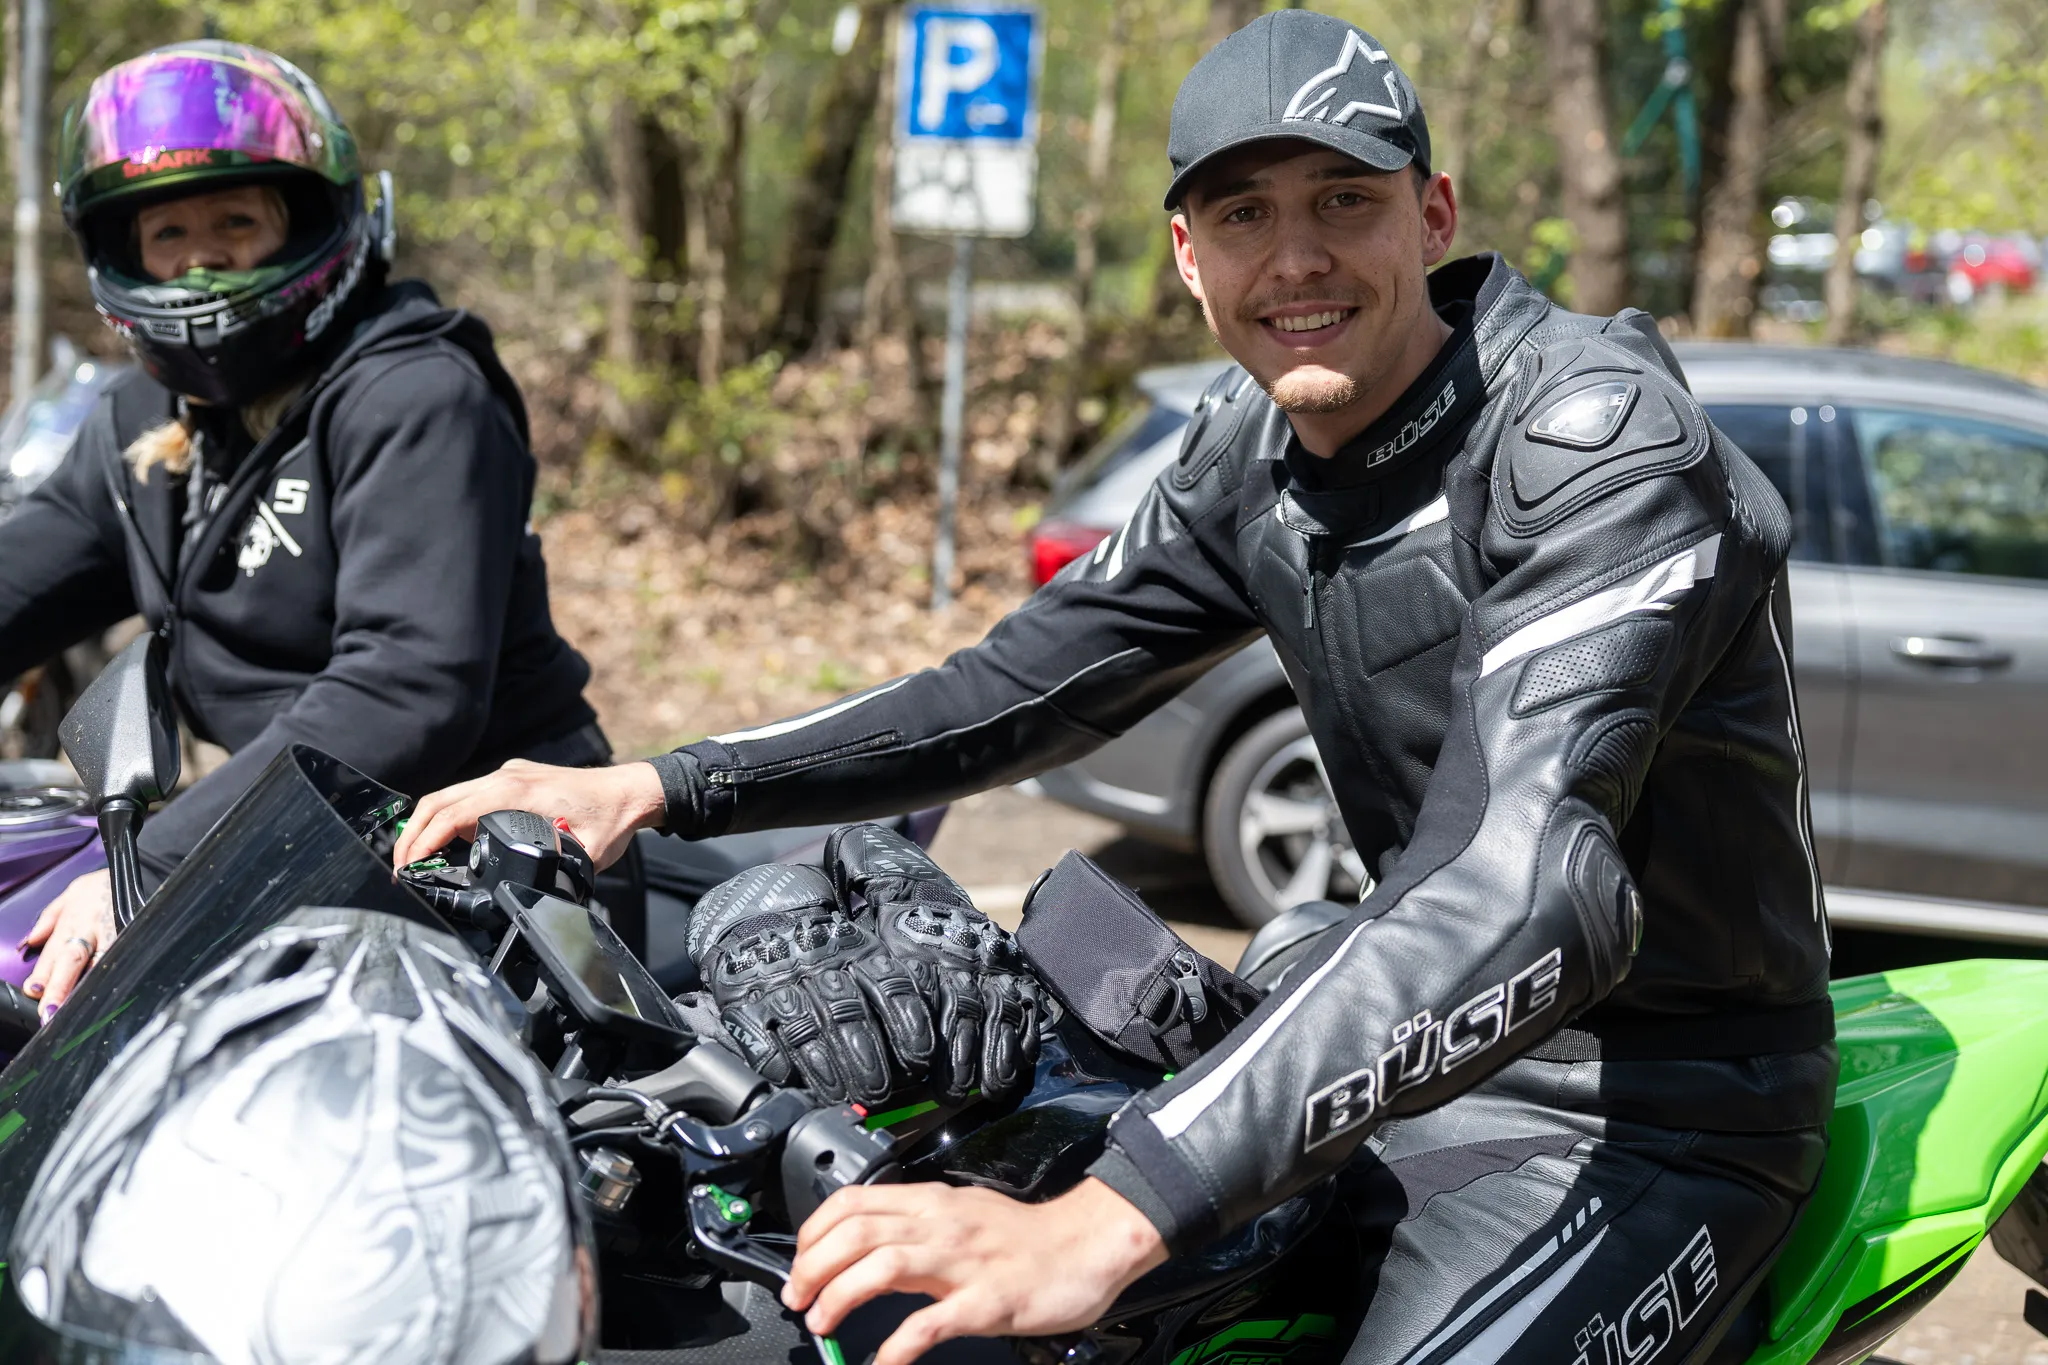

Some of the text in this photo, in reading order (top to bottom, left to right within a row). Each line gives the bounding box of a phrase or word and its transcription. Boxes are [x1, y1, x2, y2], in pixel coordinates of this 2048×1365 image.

[918, 16, 1001, 132] P
[1366, 379, 1457, 468] BÜSE
[724, 1020, 765, 1056] FLM
[1304, 947, 1562, 1154] BÜSE
